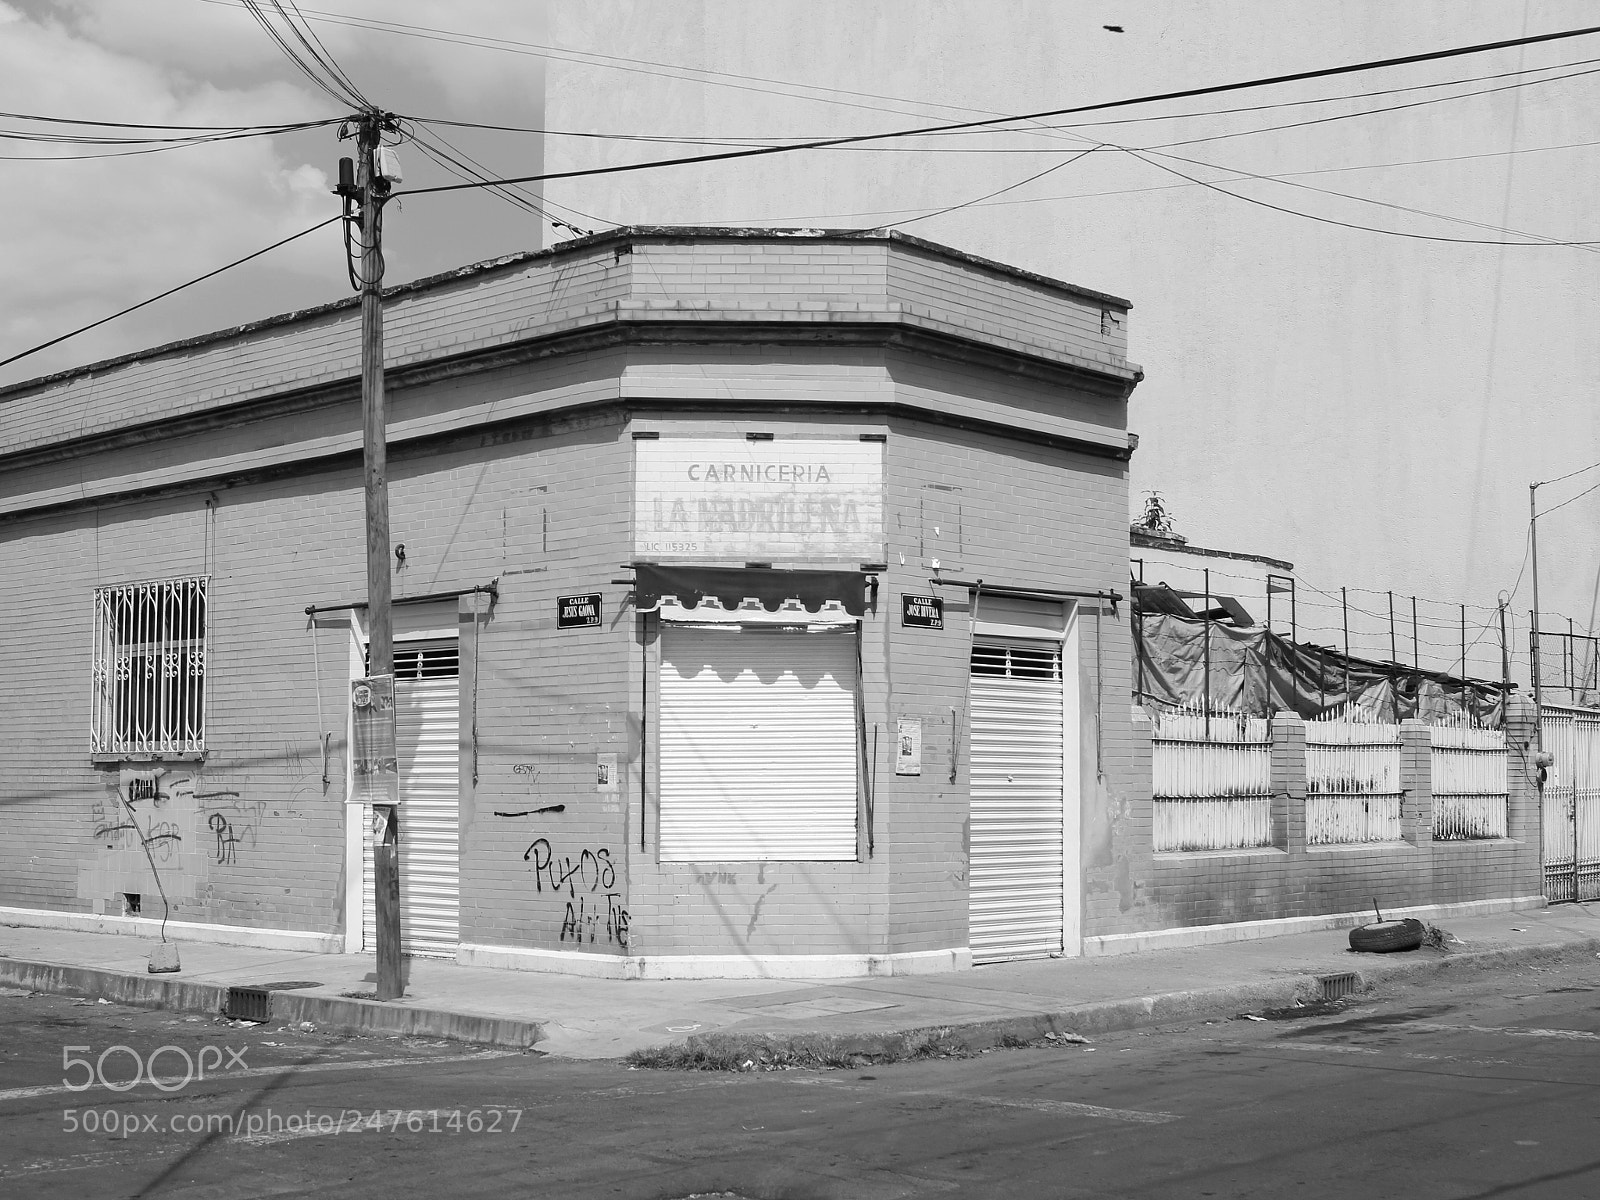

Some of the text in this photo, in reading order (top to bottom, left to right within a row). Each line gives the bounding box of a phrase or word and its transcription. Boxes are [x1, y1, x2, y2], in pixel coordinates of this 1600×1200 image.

[687, 464, 831, 483] CARNICERIA
[654, 497, 689, 532] LA
[665, 542, 698, 552] 115325
[907, 604, 920, 616] JOSE
